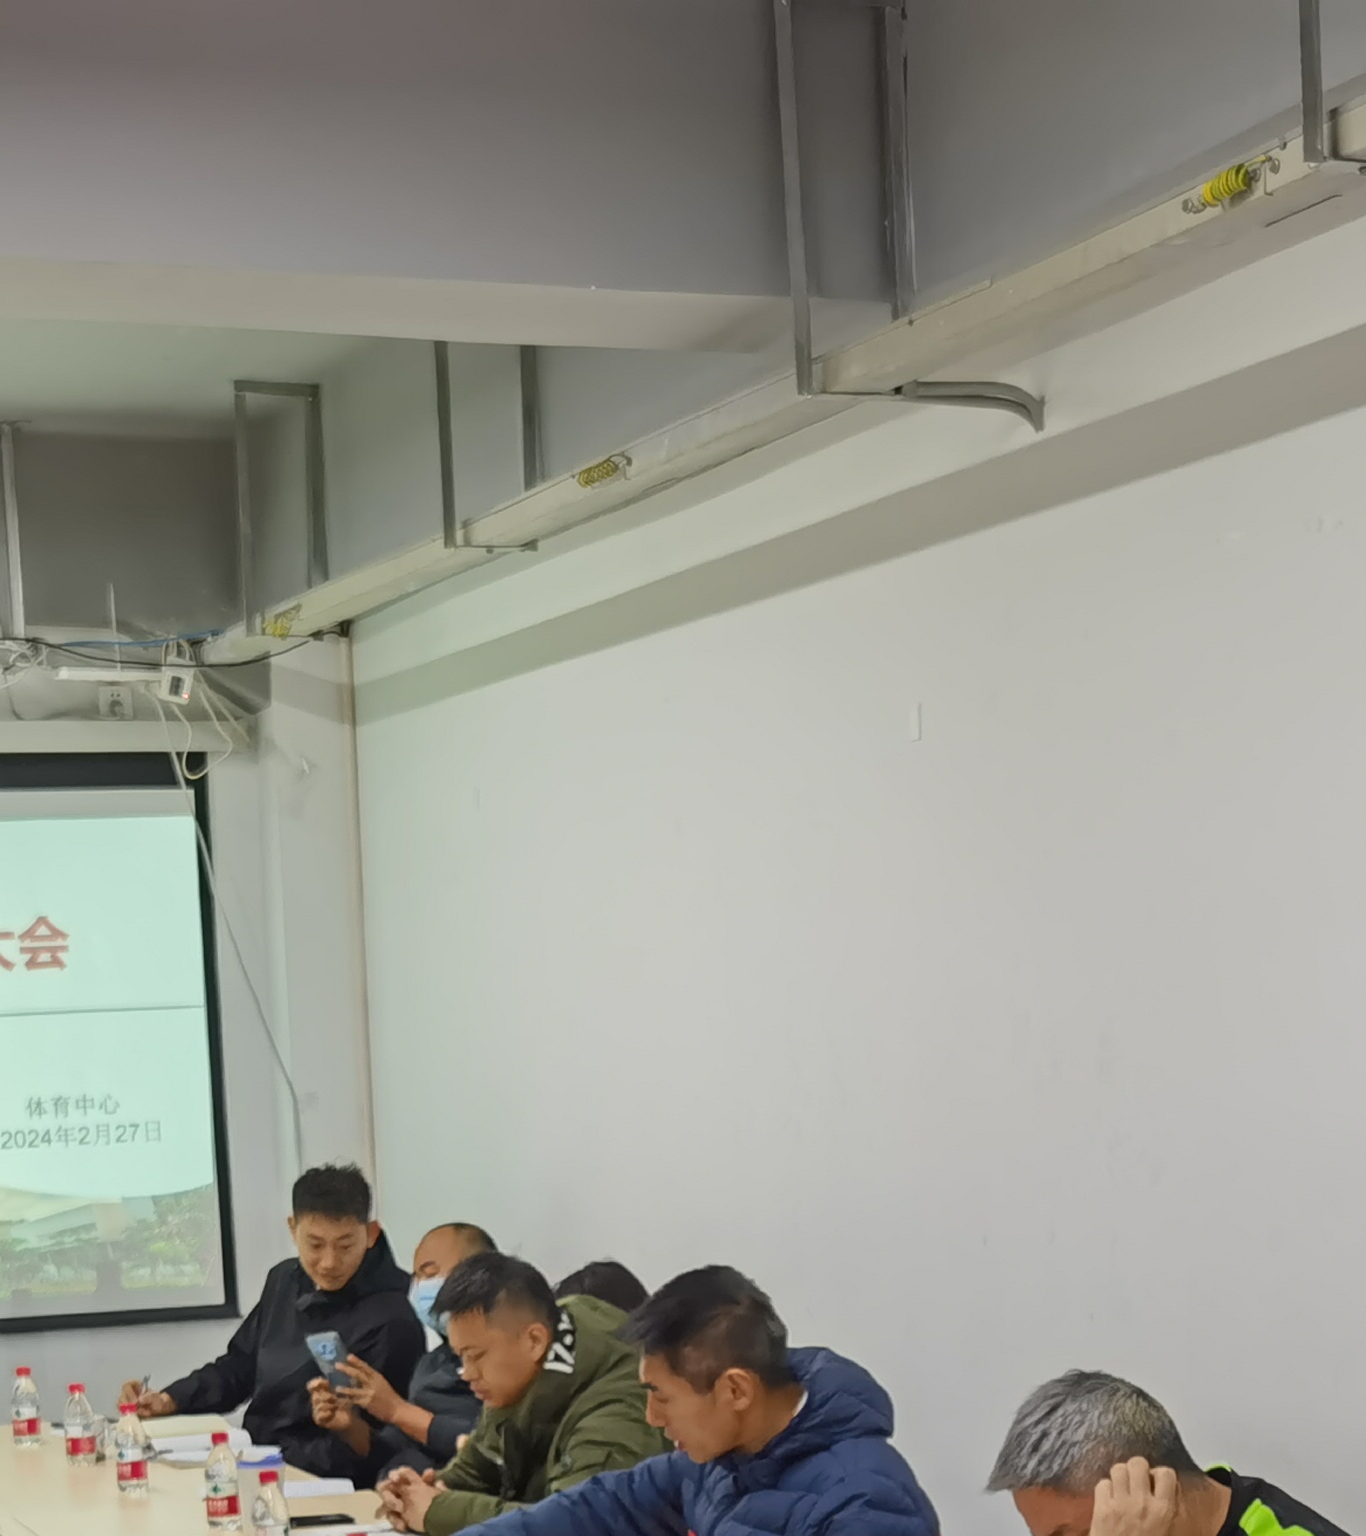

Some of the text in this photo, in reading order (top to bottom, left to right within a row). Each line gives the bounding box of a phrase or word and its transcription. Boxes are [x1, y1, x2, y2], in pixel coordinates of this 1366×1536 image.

[25, 1094, 121, 1120] 体育中心
[0, 1120, 162, 1151] 2024年2月27日
